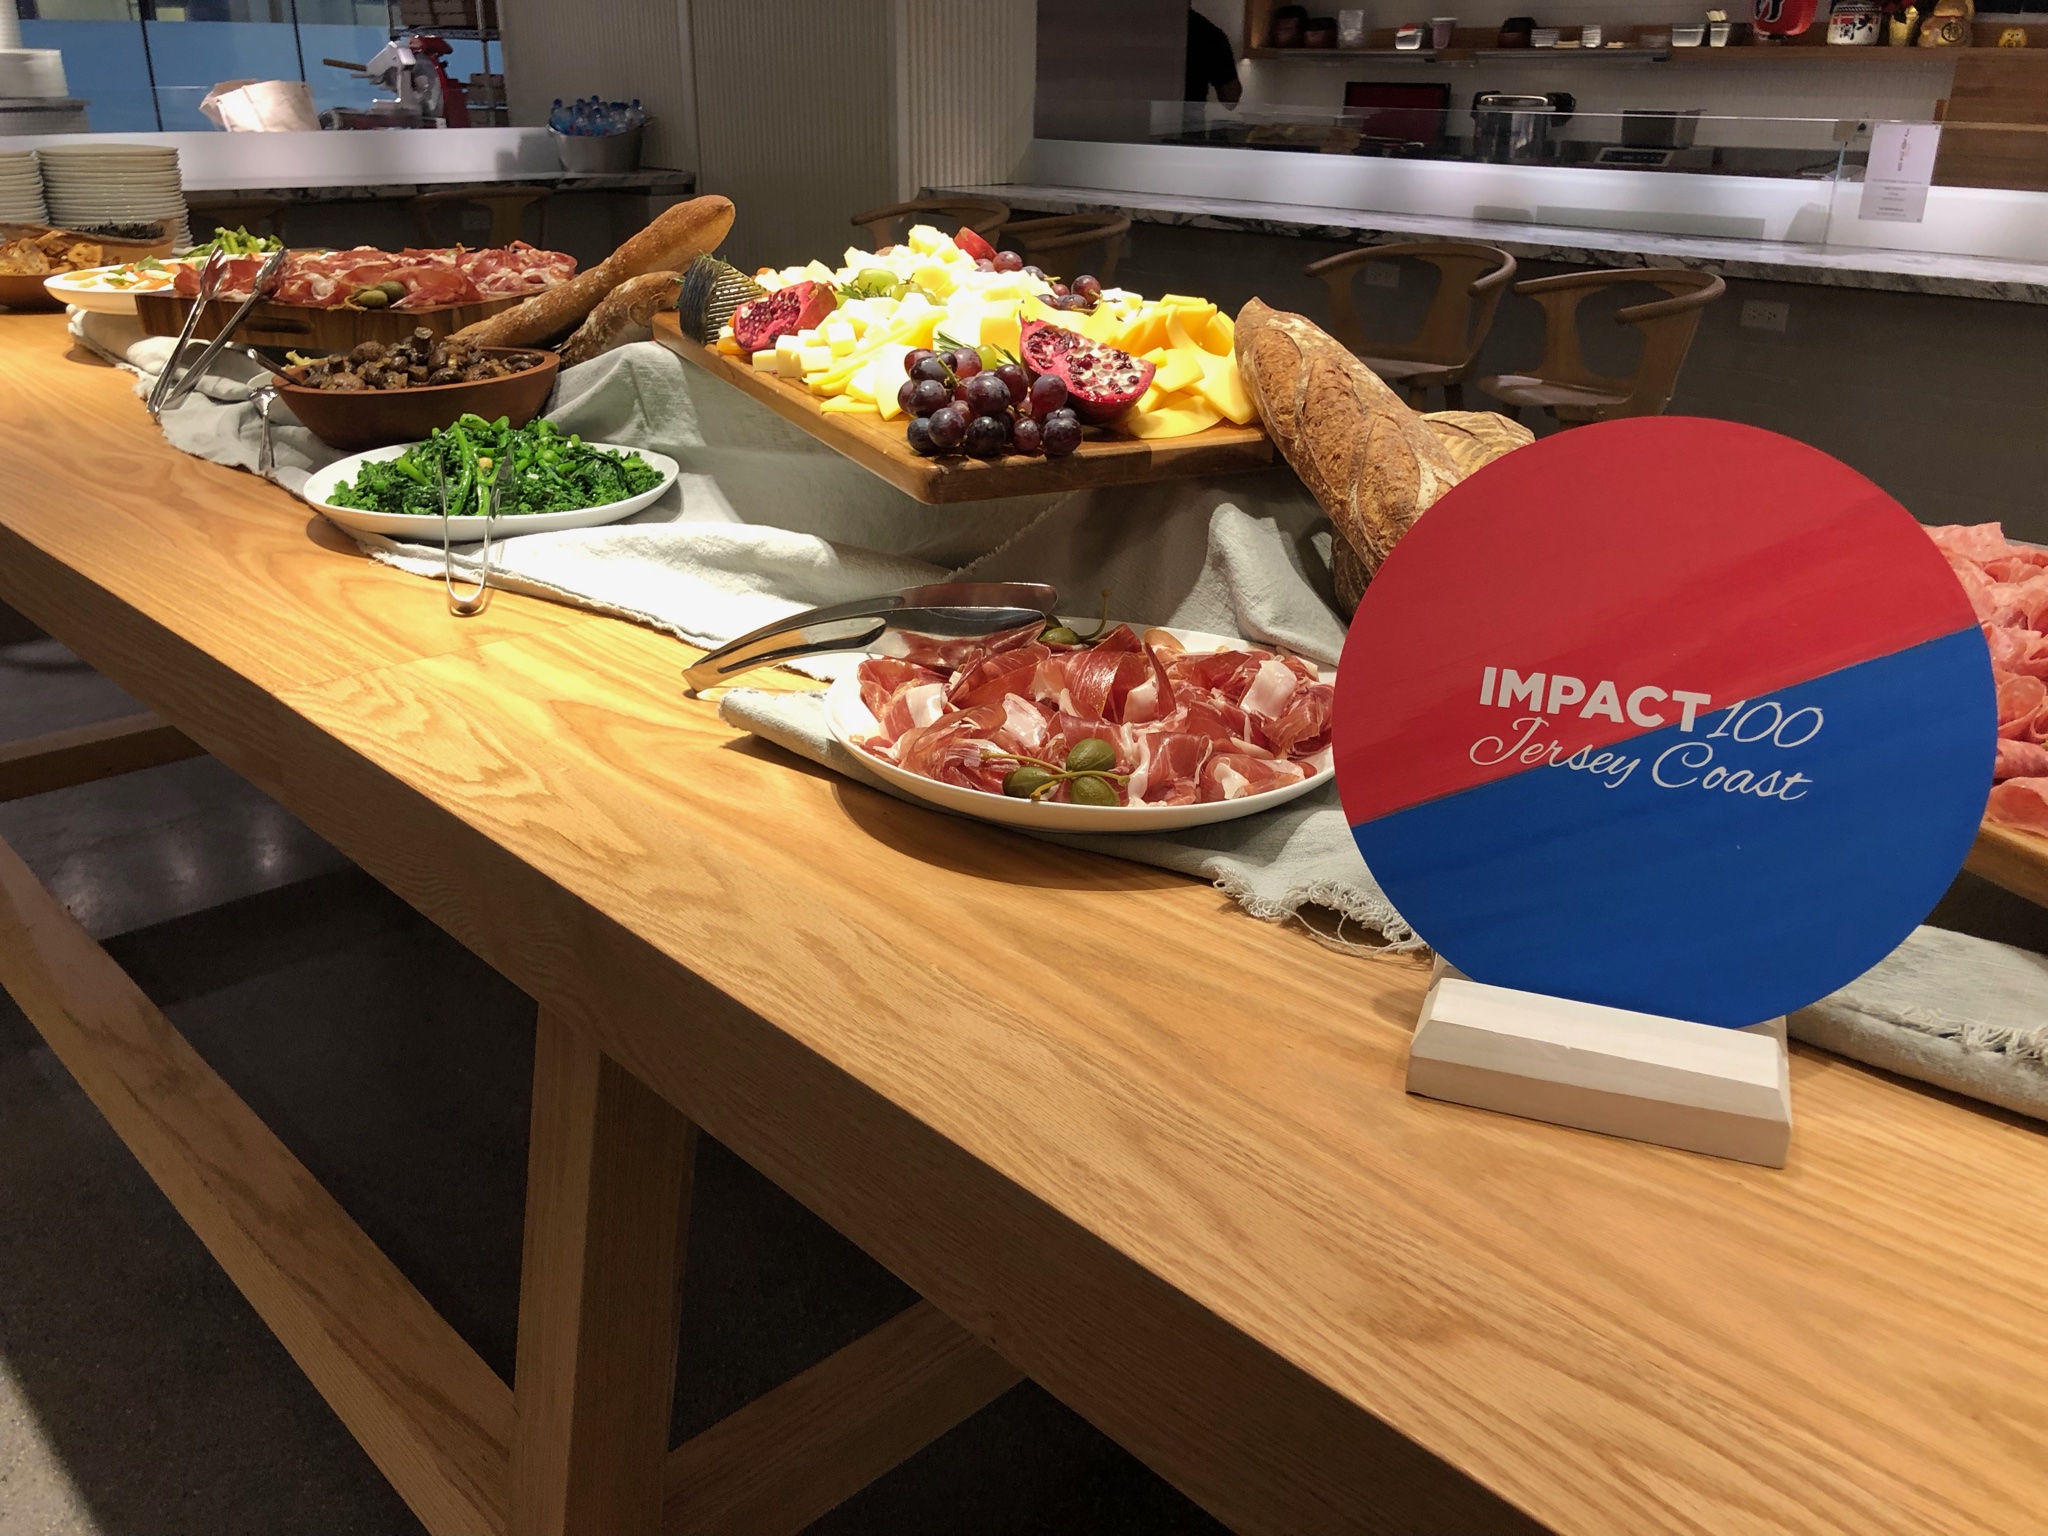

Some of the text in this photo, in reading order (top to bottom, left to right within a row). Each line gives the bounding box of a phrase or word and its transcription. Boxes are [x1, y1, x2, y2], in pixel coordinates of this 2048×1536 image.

[1479, 666, 1824, 748] IMPACT 100
[1469, 716, 1813, 801] Jersey Coast
